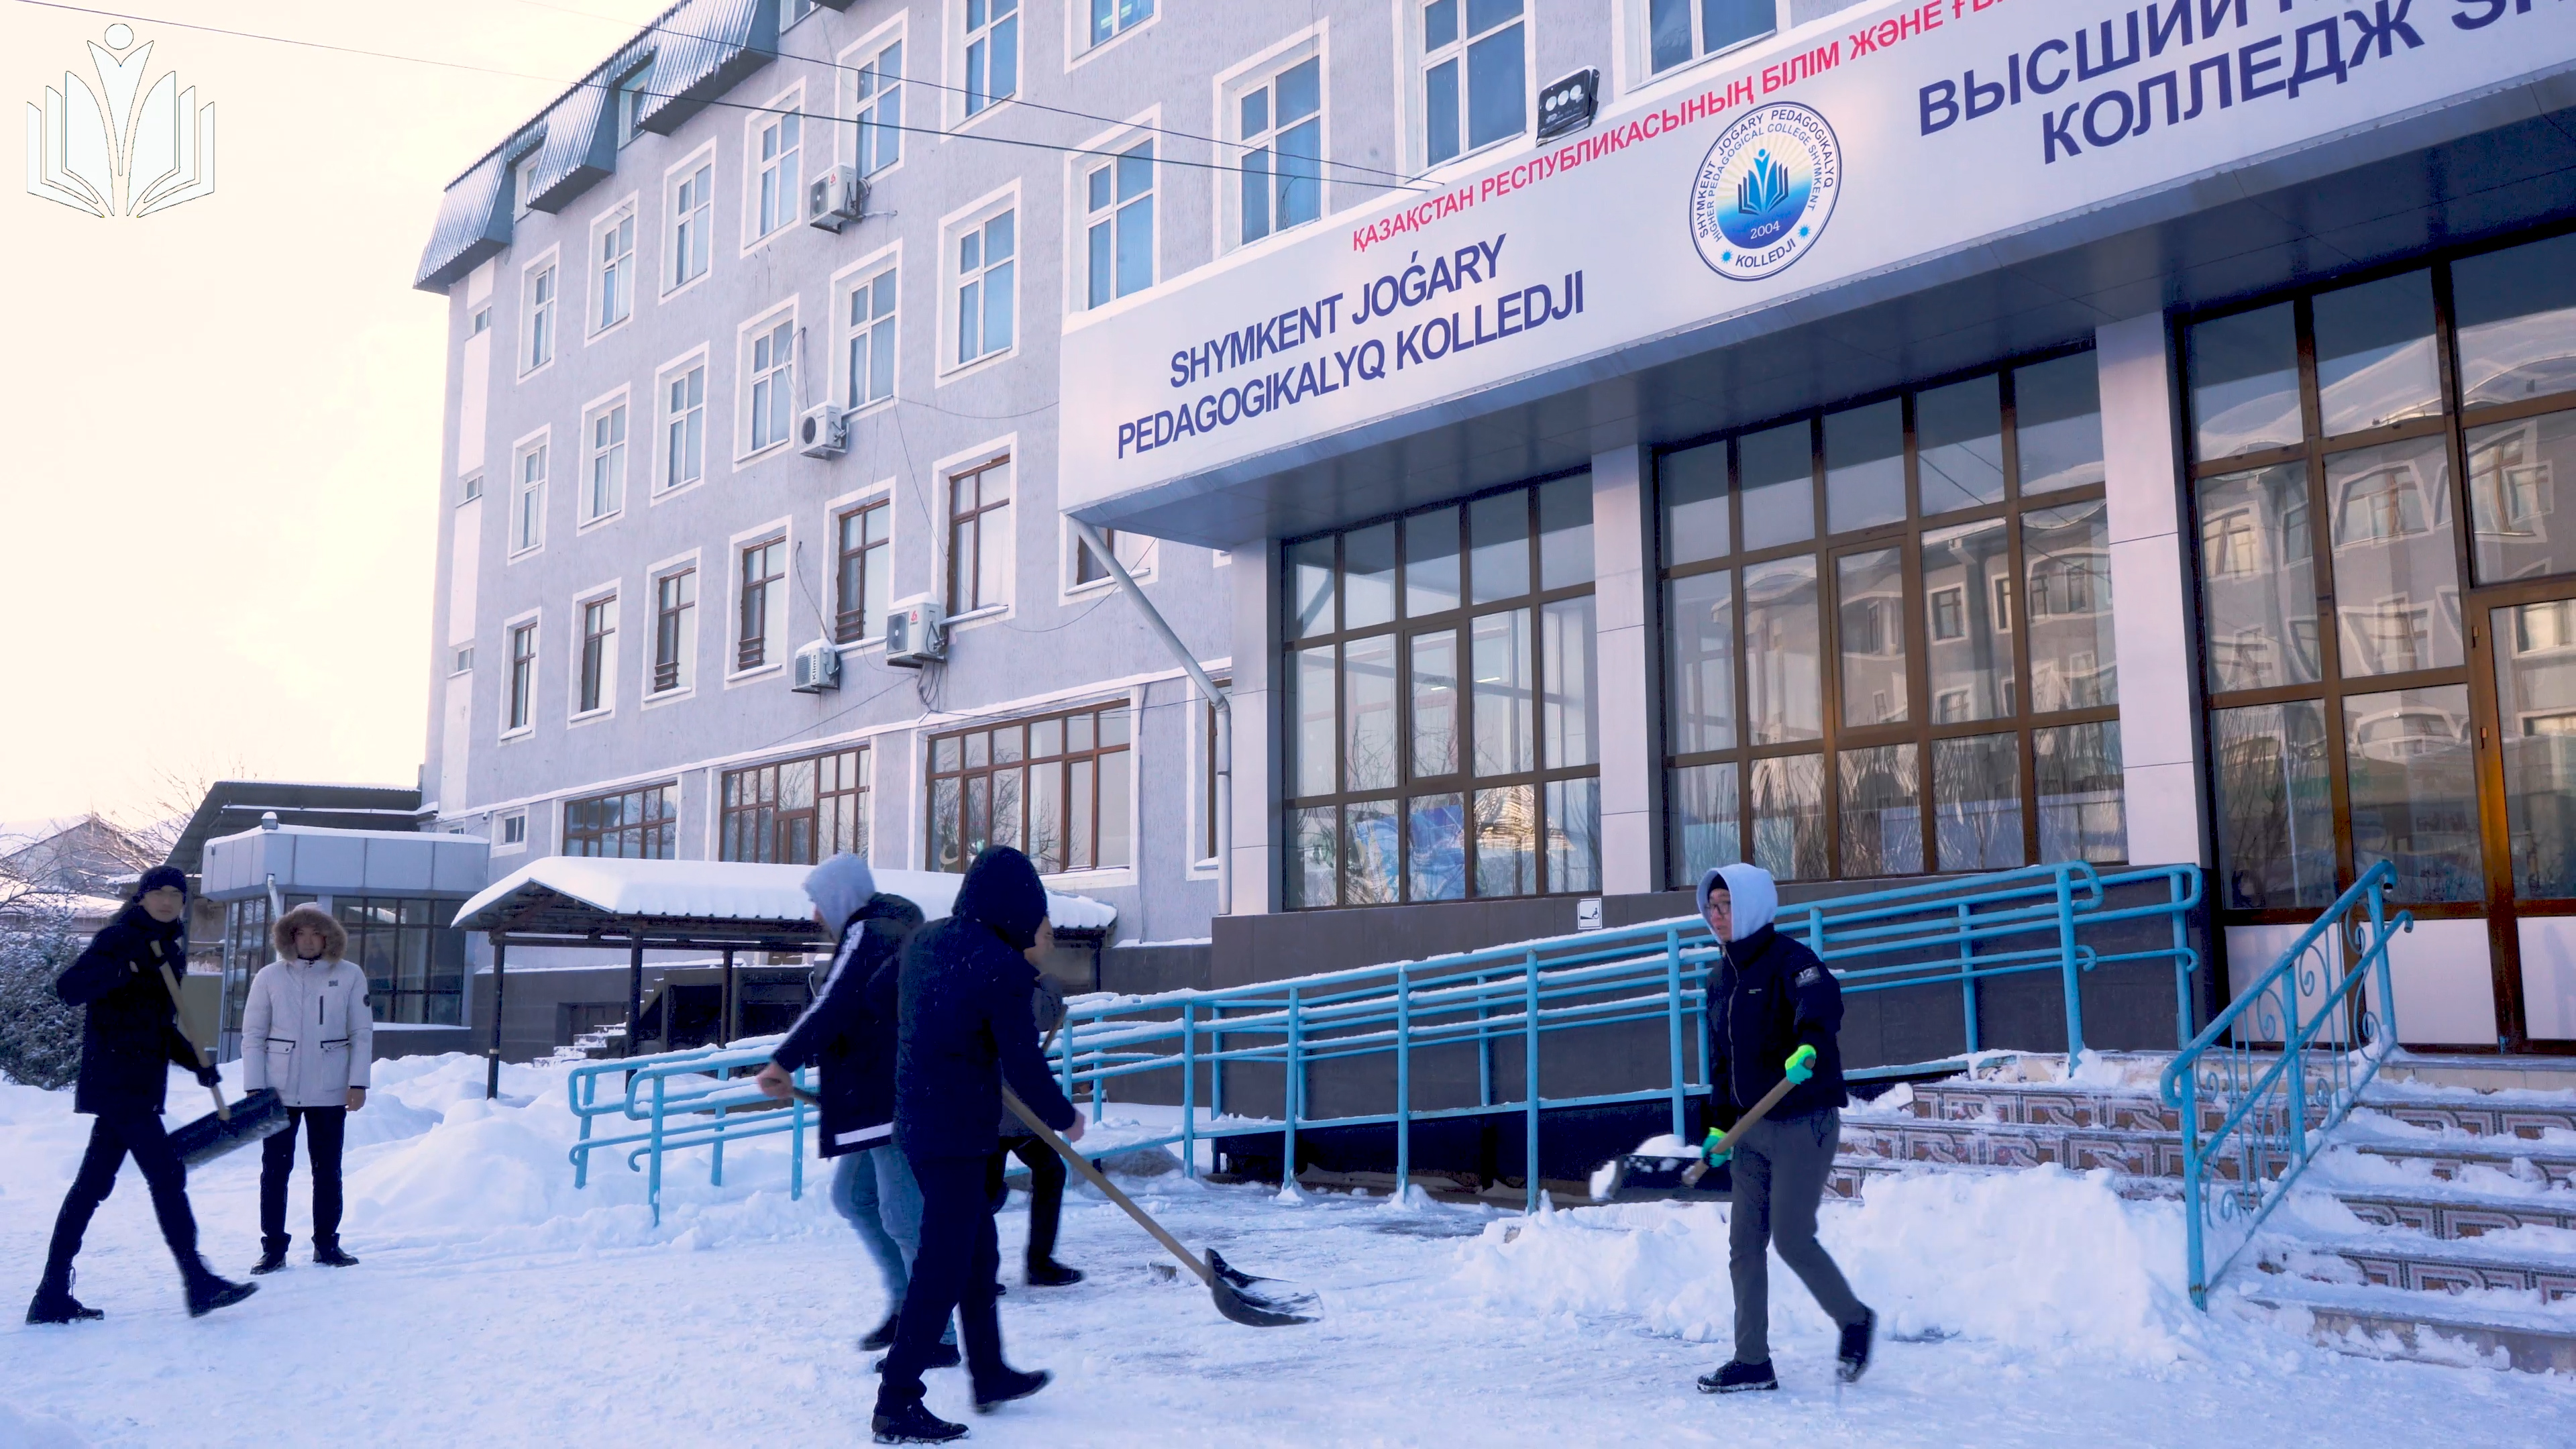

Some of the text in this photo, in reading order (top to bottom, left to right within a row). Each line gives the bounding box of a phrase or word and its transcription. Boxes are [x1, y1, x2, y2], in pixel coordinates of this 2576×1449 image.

[1353, 0, 1943, 252] ҚАЗАҚСТАН РЕСПУБЛИКАСЫНЫҢ БІЛІМ ЖӘНЕ
[2043, 0, 2425, 164] КОЛЛЕДЖ
[1697, 160, 1716, 238] SHYMKENT
[1771, 109, 1834, 189] PEDAGOGIKALYQ
[1707, 123, 1822, 242] HIGHER PEDAGOGICAL COLLEGE SHYMKENT
[1750, 220, 1780, 240] 2004
[1171, 233, 1507, 388] SHYMKENT JOǴARY
[1735, 238, 1796, 268] KOLLEDJI
[1118, 270, 1583, 460] PEDAGOGIKALYQ KOLLEDJI
[1799, 968, 1815, 979] 12
